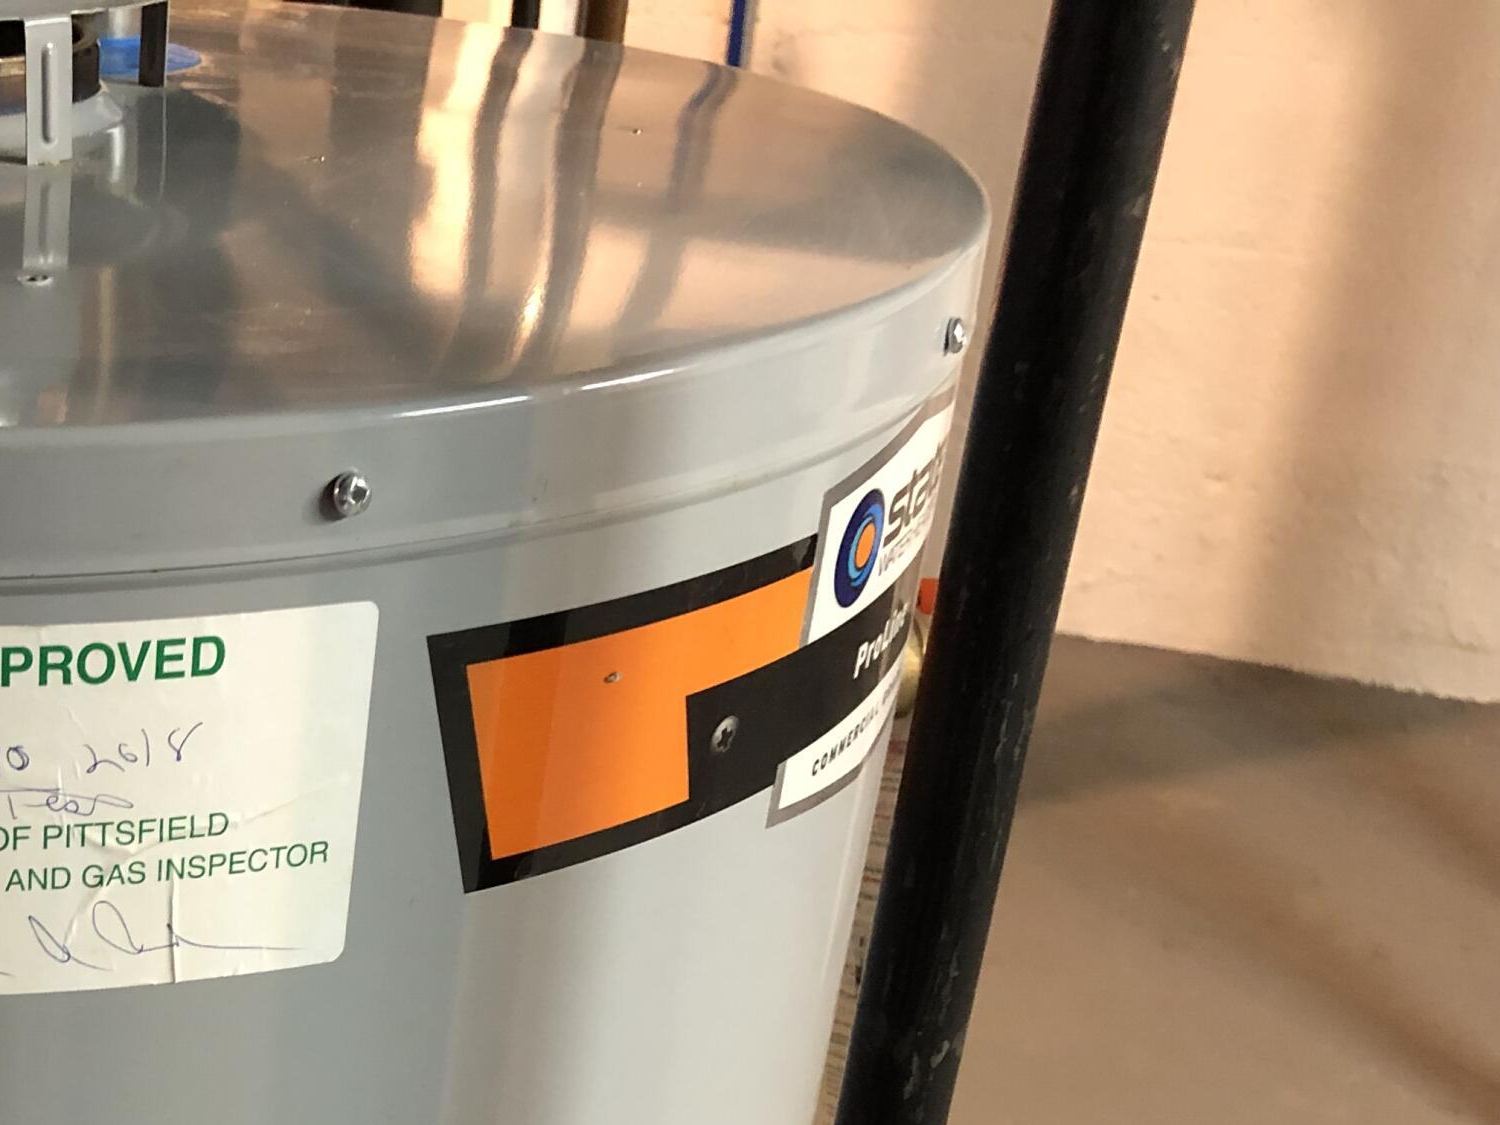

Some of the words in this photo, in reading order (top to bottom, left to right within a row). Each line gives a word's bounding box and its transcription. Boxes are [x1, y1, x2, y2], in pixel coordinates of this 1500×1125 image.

[43, 811, 229, 850] PITTSFIELD
[5, 866, 72, 892] AND
[81, 857, 148, 888] GAS
[156, 840, 329, 881] INSPECTOR
